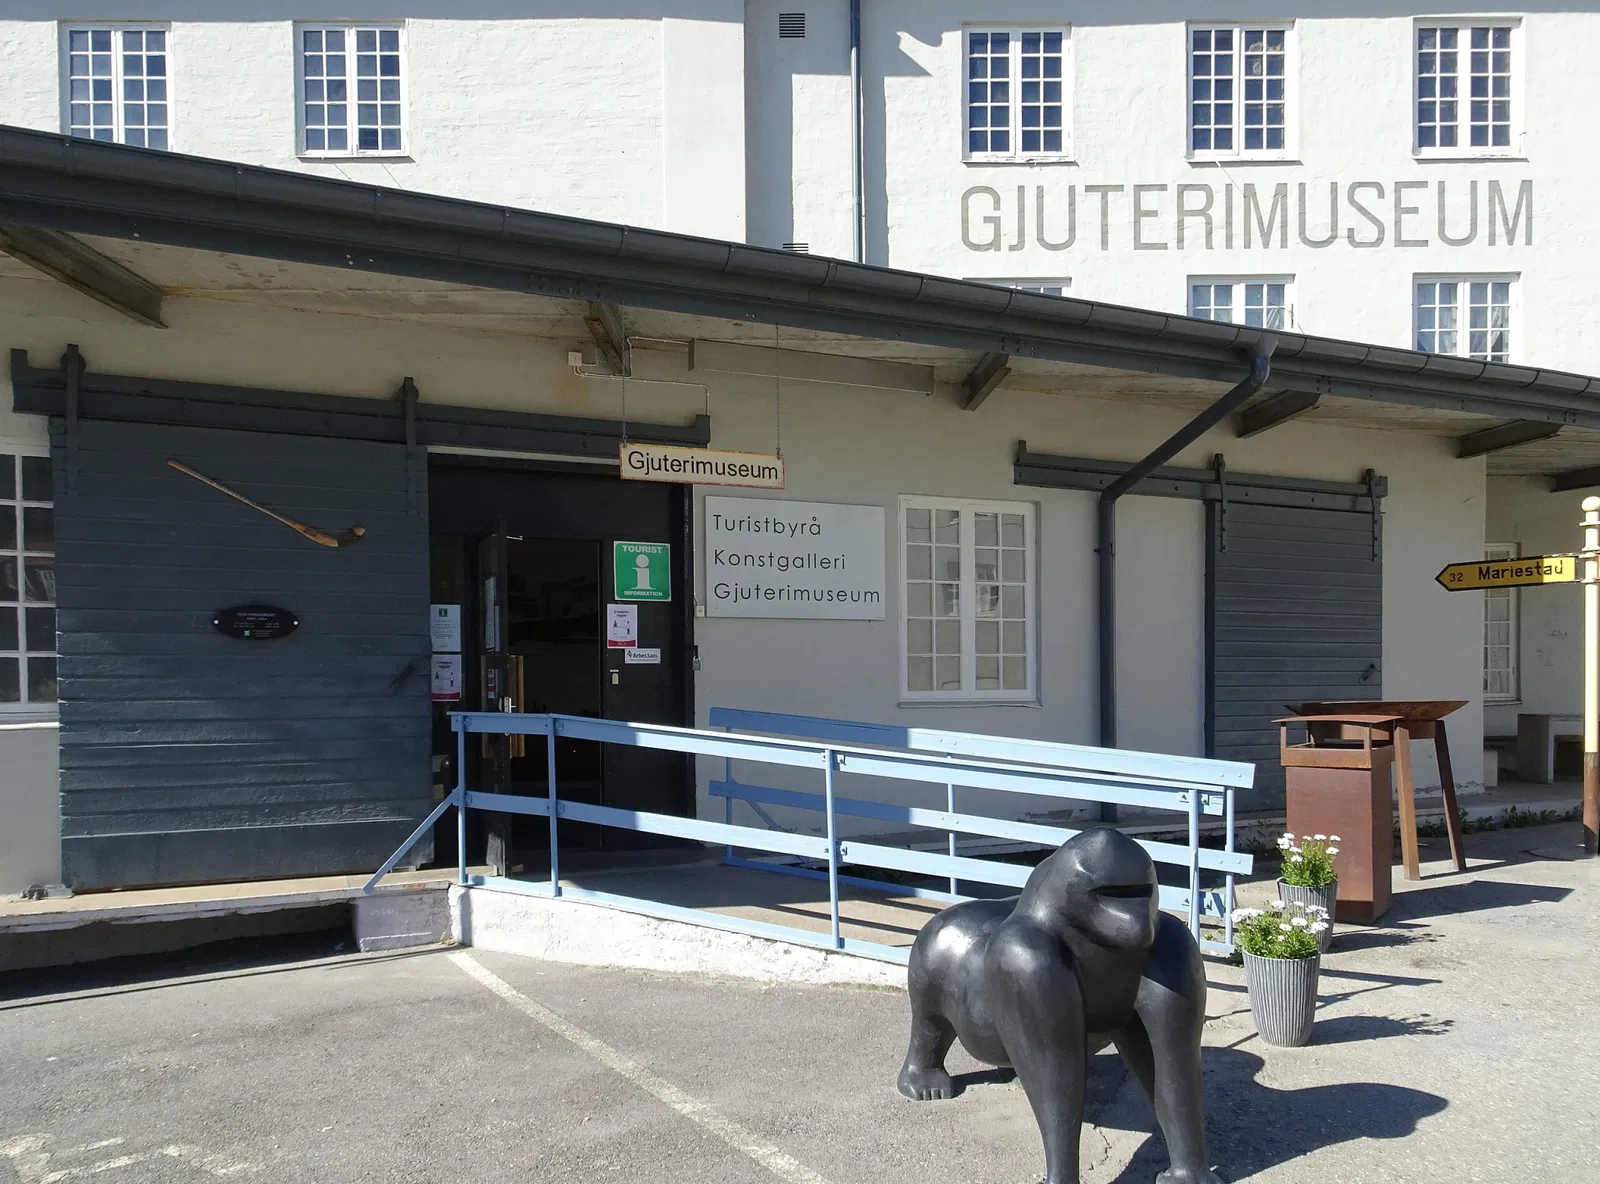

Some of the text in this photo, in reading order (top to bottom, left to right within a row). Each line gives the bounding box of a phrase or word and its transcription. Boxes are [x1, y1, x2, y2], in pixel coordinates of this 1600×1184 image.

[960, 179, 1533, 252] GJUTERIMUSEUM
[627, 450, 778, 480] Gjuterimuseum
[713, 514, 822, 538] Turistbyrå
[621, 544, 663, 554] TOURIST
[714, 549, 846, 571] Konstgalleri
[1449, 560, 1563, 583] 32 Mariestad
[714, 582, 880, 603] Gjuterimuseum
